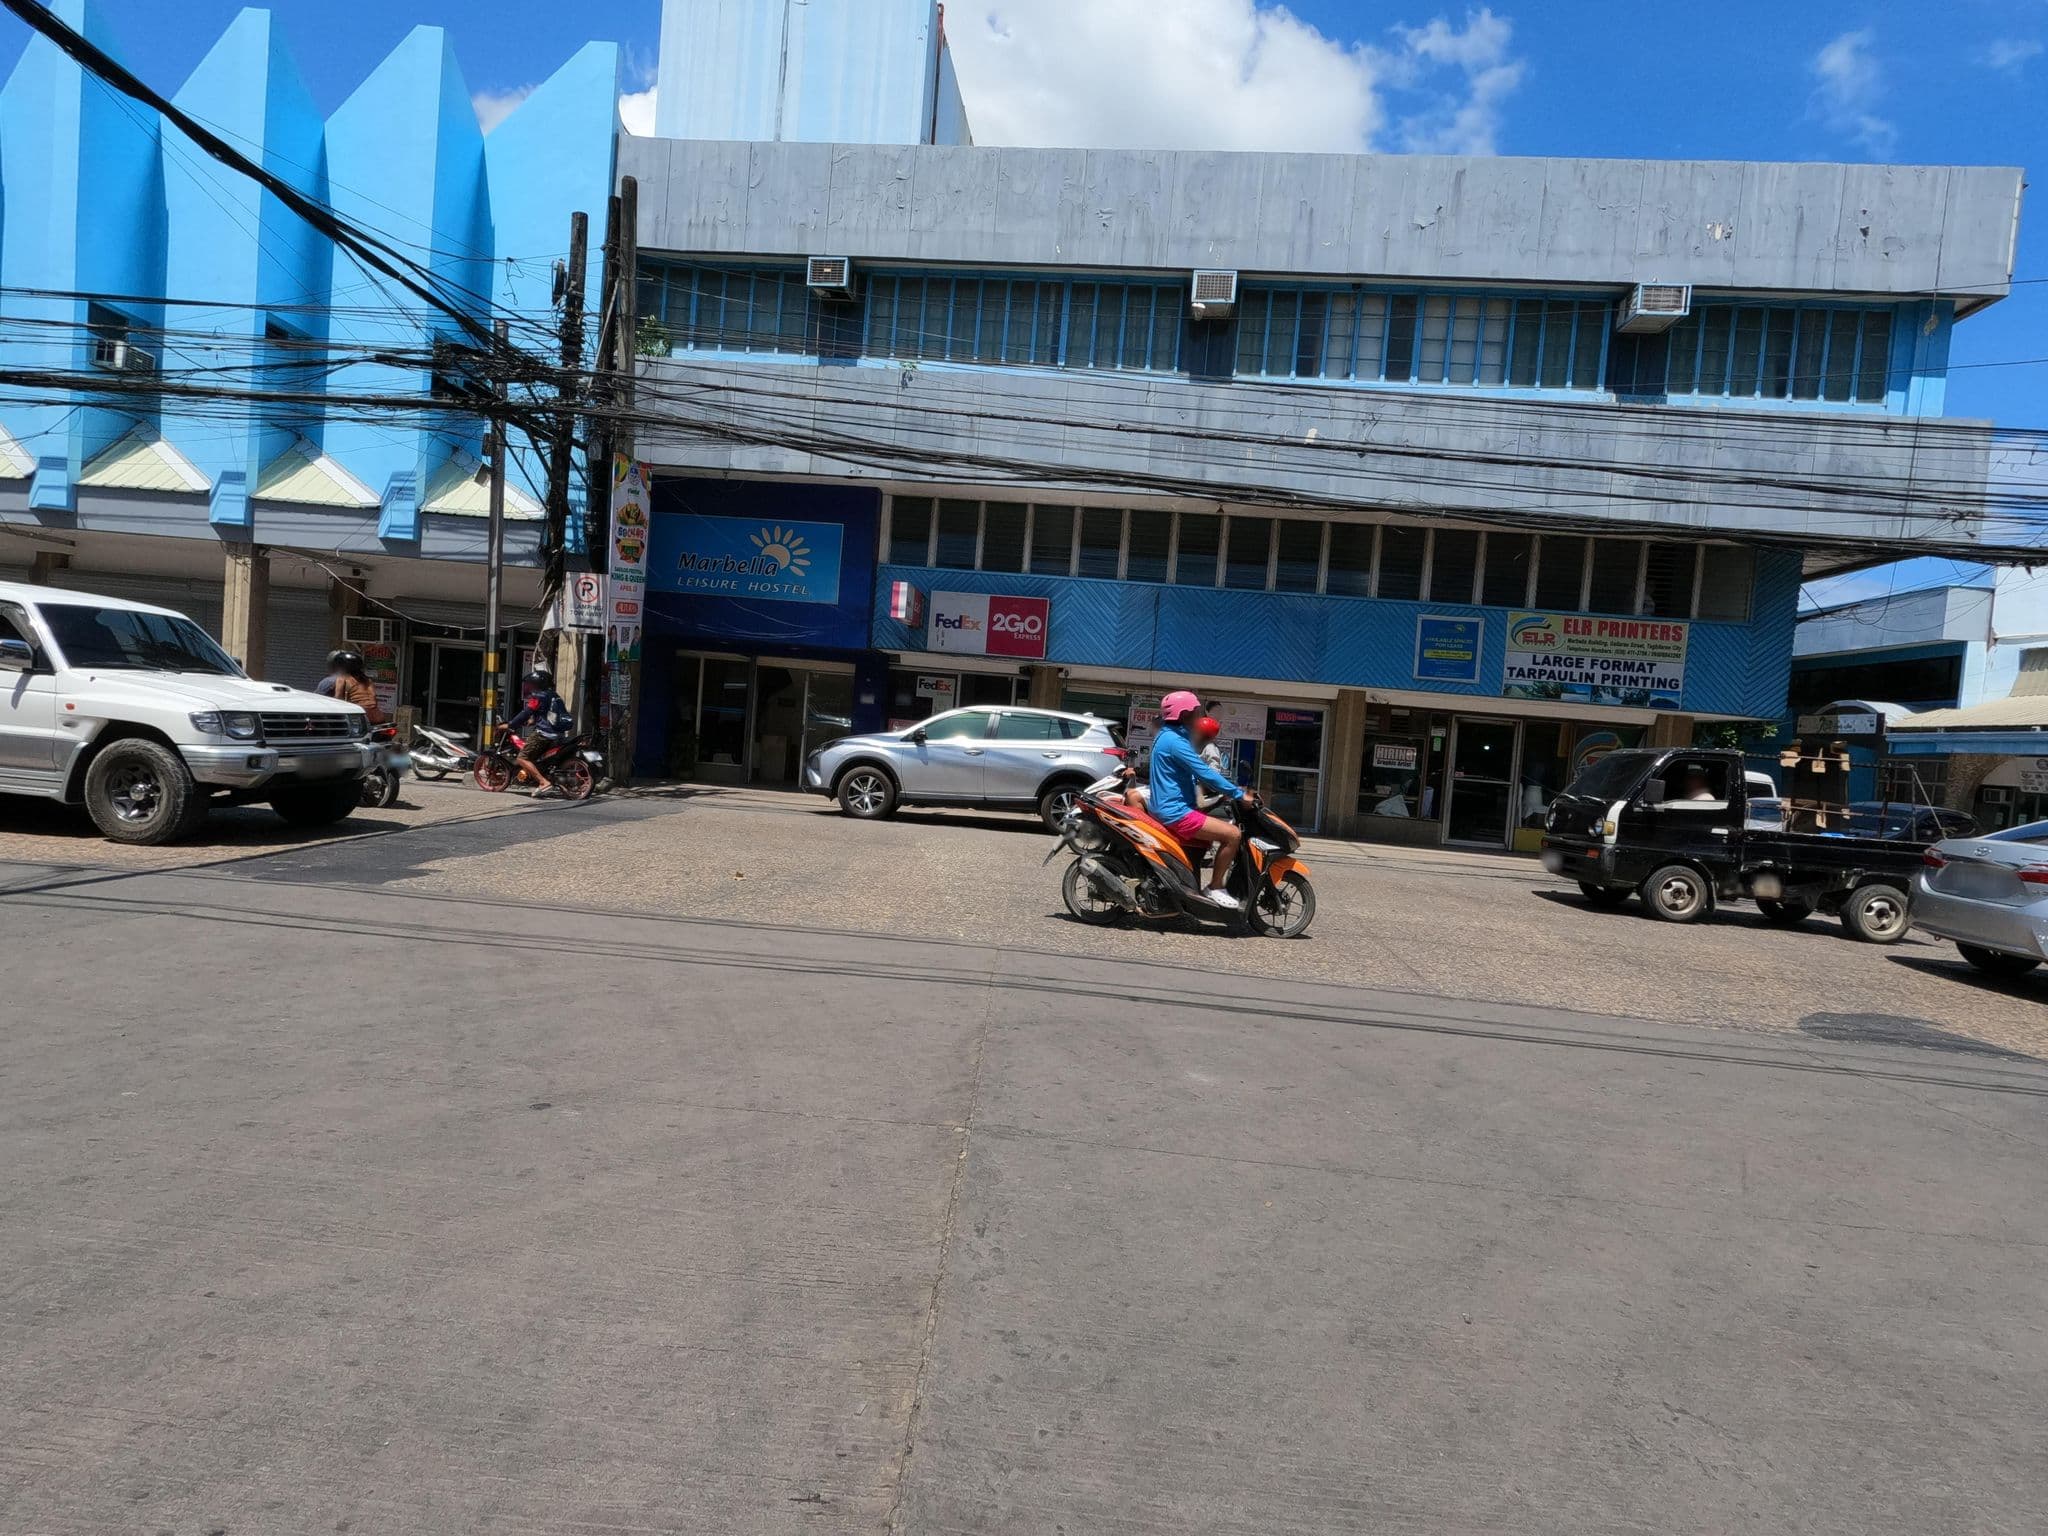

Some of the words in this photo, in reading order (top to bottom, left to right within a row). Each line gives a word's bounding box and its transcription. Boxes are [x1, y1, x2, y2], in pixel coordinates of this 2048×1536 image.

[678, 552, 778, 577] Marbella
[677, 577, 738, 590] LEISURE
[748, 582, 808, 595] HOSTEL
[935, 613, 982, 631] FedEx
[992, 612, 1042, 634] 2GO
[1563, 618, 1594, 636] ELR
[1598, 620, 1683, 641] PRINTERS
[1522, 631, 1555, 642] ELR
[1532, 654, 1584, 669] LARGE
[1590, 658, 1656, 674] FORMAT
[918, 678, 952, 692] FedEx
[1507, 666, 1595, 683] TARPAULIN
[1601, 673, 1680, 689] PRINTING
[1376, 746, 1415, 762] HIRING
